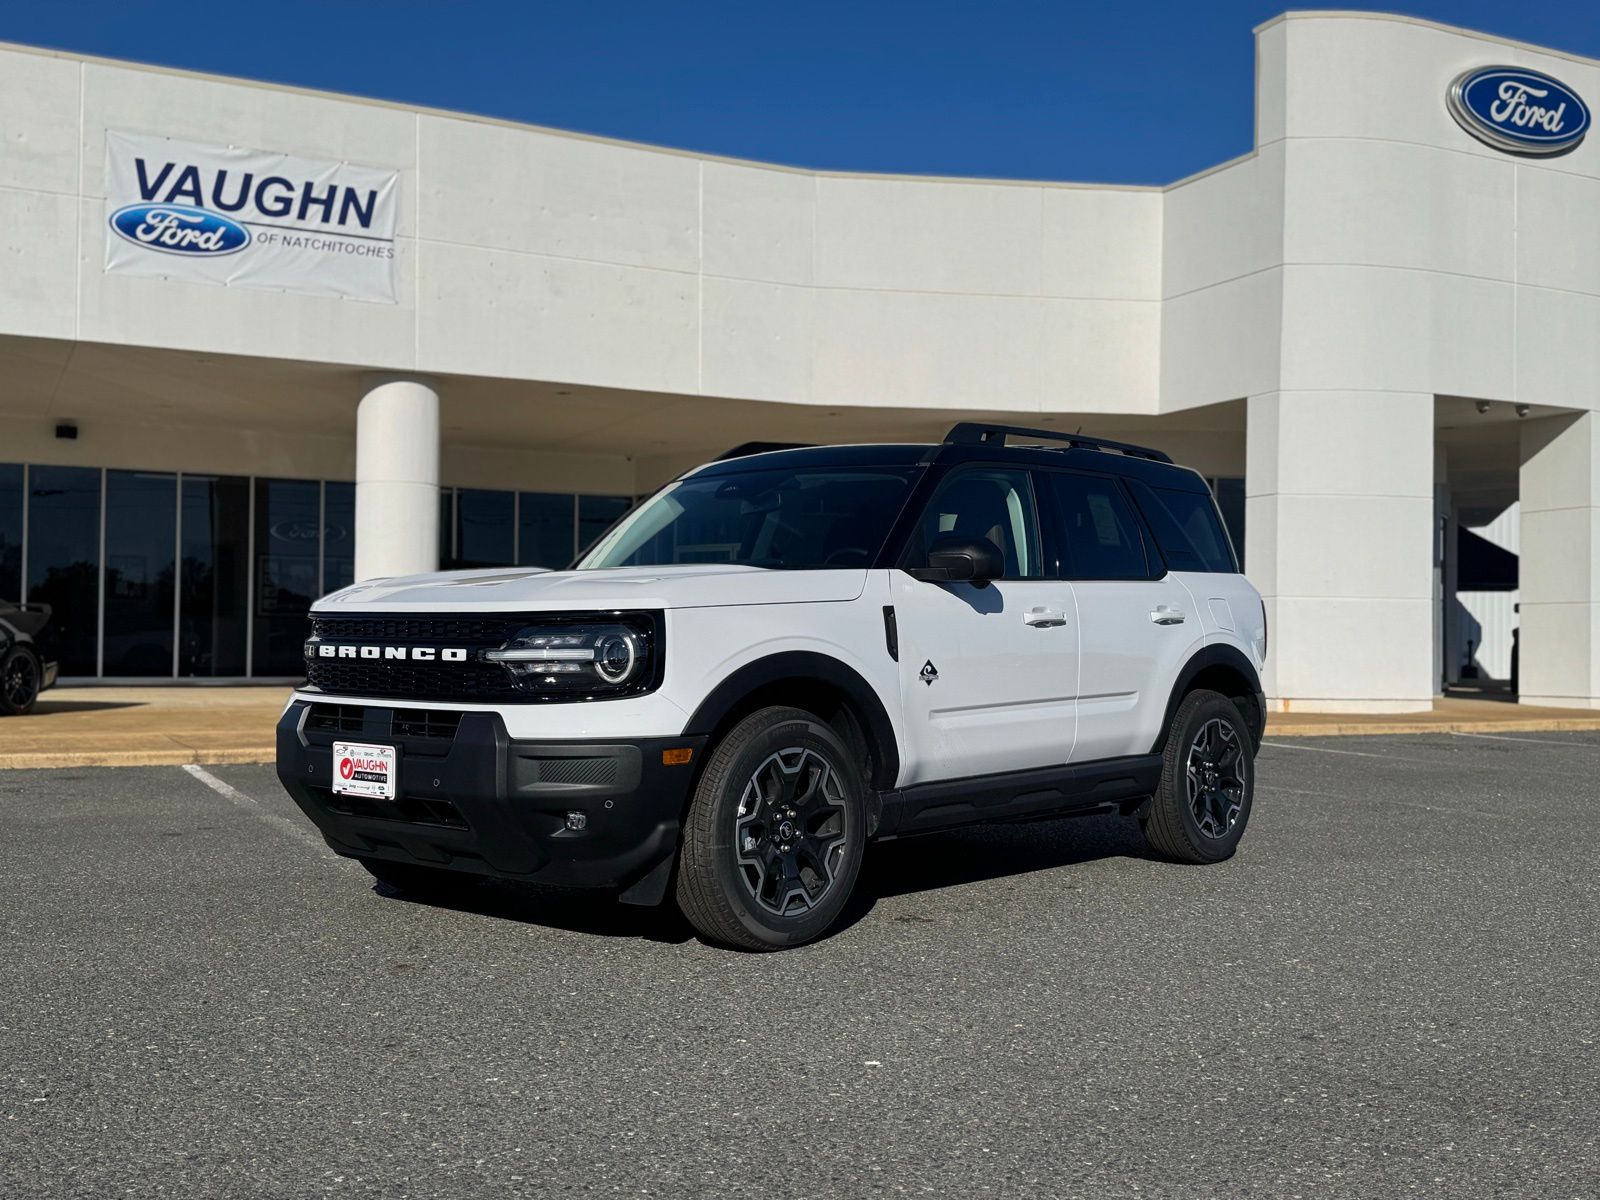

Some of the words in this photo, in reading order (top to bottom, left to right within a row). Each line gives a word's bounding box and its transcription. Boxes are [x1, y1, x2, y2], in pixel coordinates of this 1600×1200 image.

[1490, 81, 1566, 133] Ford
[135, 158, 378, 229] VAUGHN
[135, 209, 227, 251] Ford
[257, 232, 276, 244] OF
[282, 235, 395, 260] NATCHITOCHES
[319, 645, 467, 661] BRONCO
[353, 758, 388, 772] VAUGHN
[354, 772, 387, 782] AUTOMOTIVE
